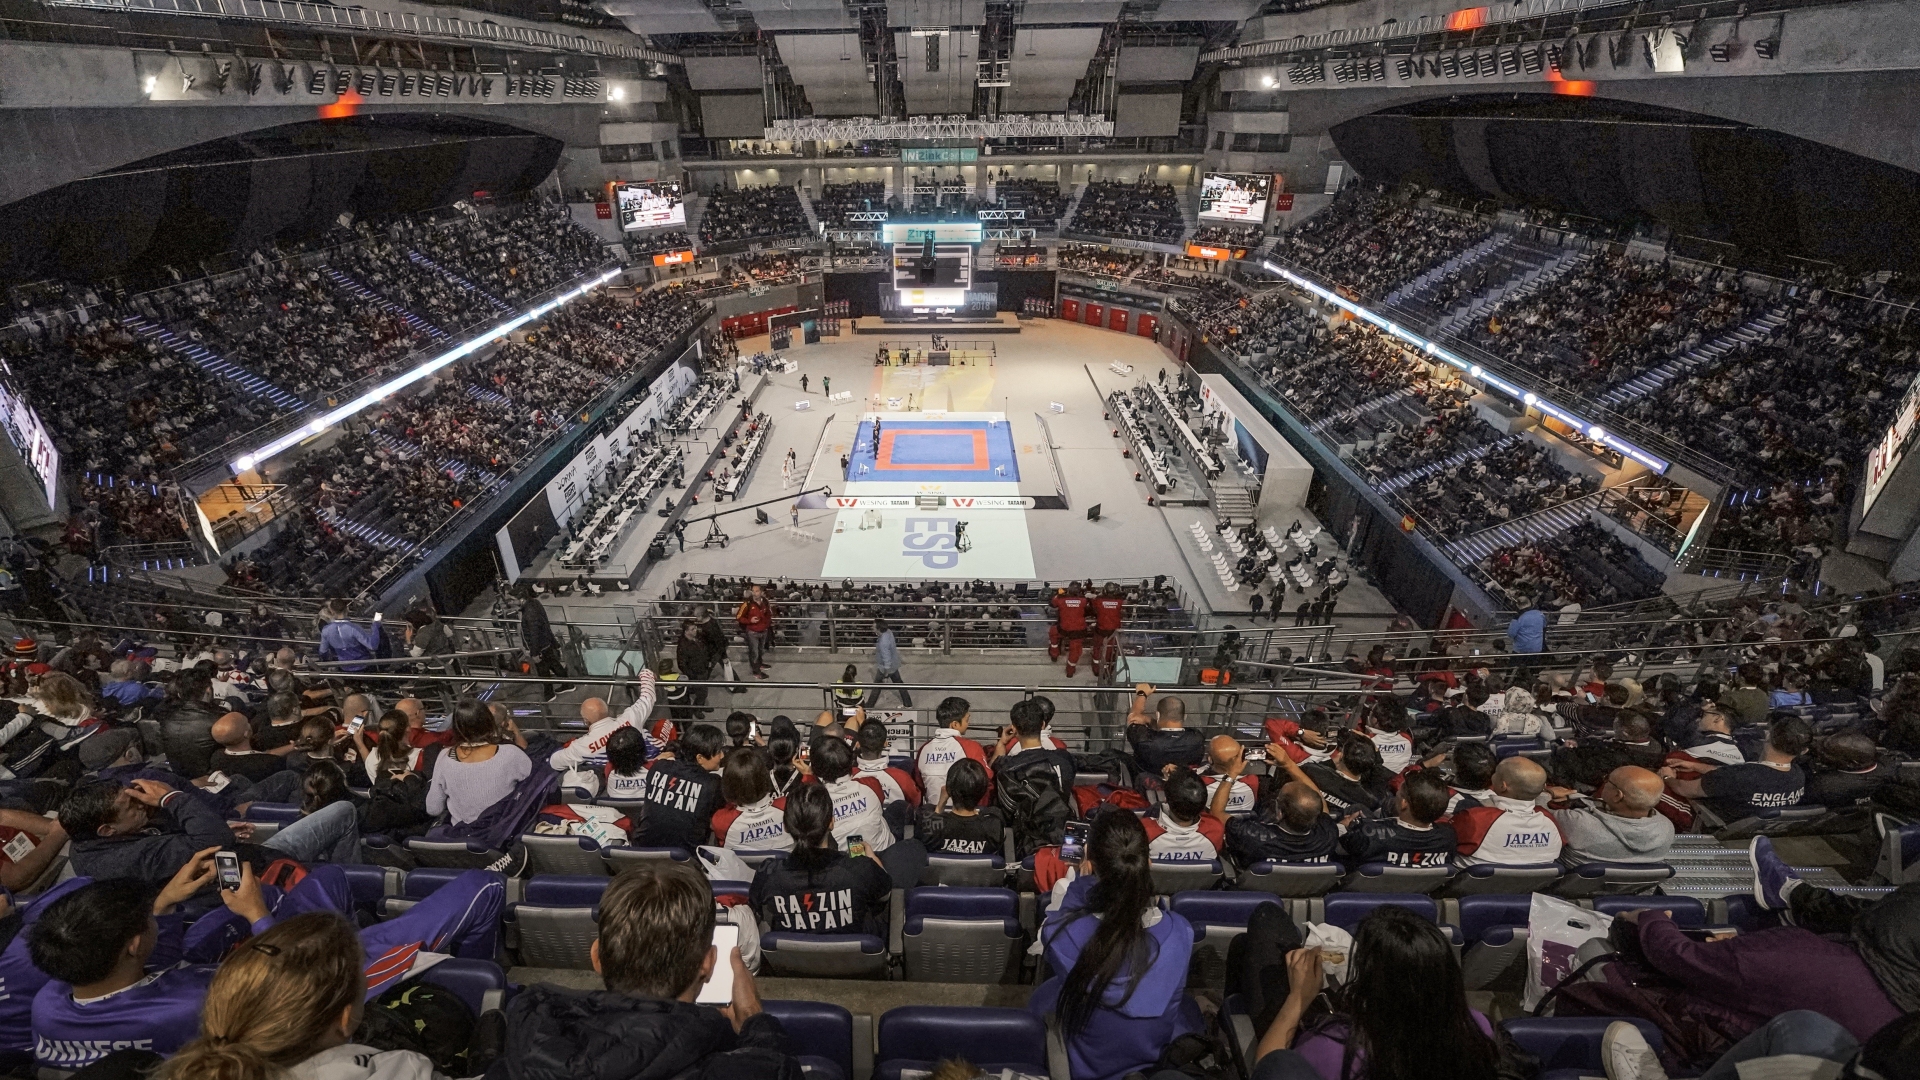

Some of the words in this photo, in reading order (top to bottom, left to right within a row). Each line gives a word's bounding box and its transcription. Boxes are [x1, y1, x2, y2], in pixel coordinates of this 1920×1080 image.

[971, 302, 991, 311] 2018
[1377, 743, 1406, 752] JAPAN
[925, 752, 956, 764] JAPAN
[1706, 748, 1743, 761] ARGENTINA
[615, 779, 648, 790] JAPAN
[647, 786, 698, 813] JAPAN
[833, 797, 868, 819] APAN
[747, 818, 775, 829] YAMADA
[740, 822, 784, 844] JAPAN
[1504, 832, 1551, 847] JAPAN
[941, 839, 987, 853] JAPAN
[780, 907, 853, 930] JAPAN
